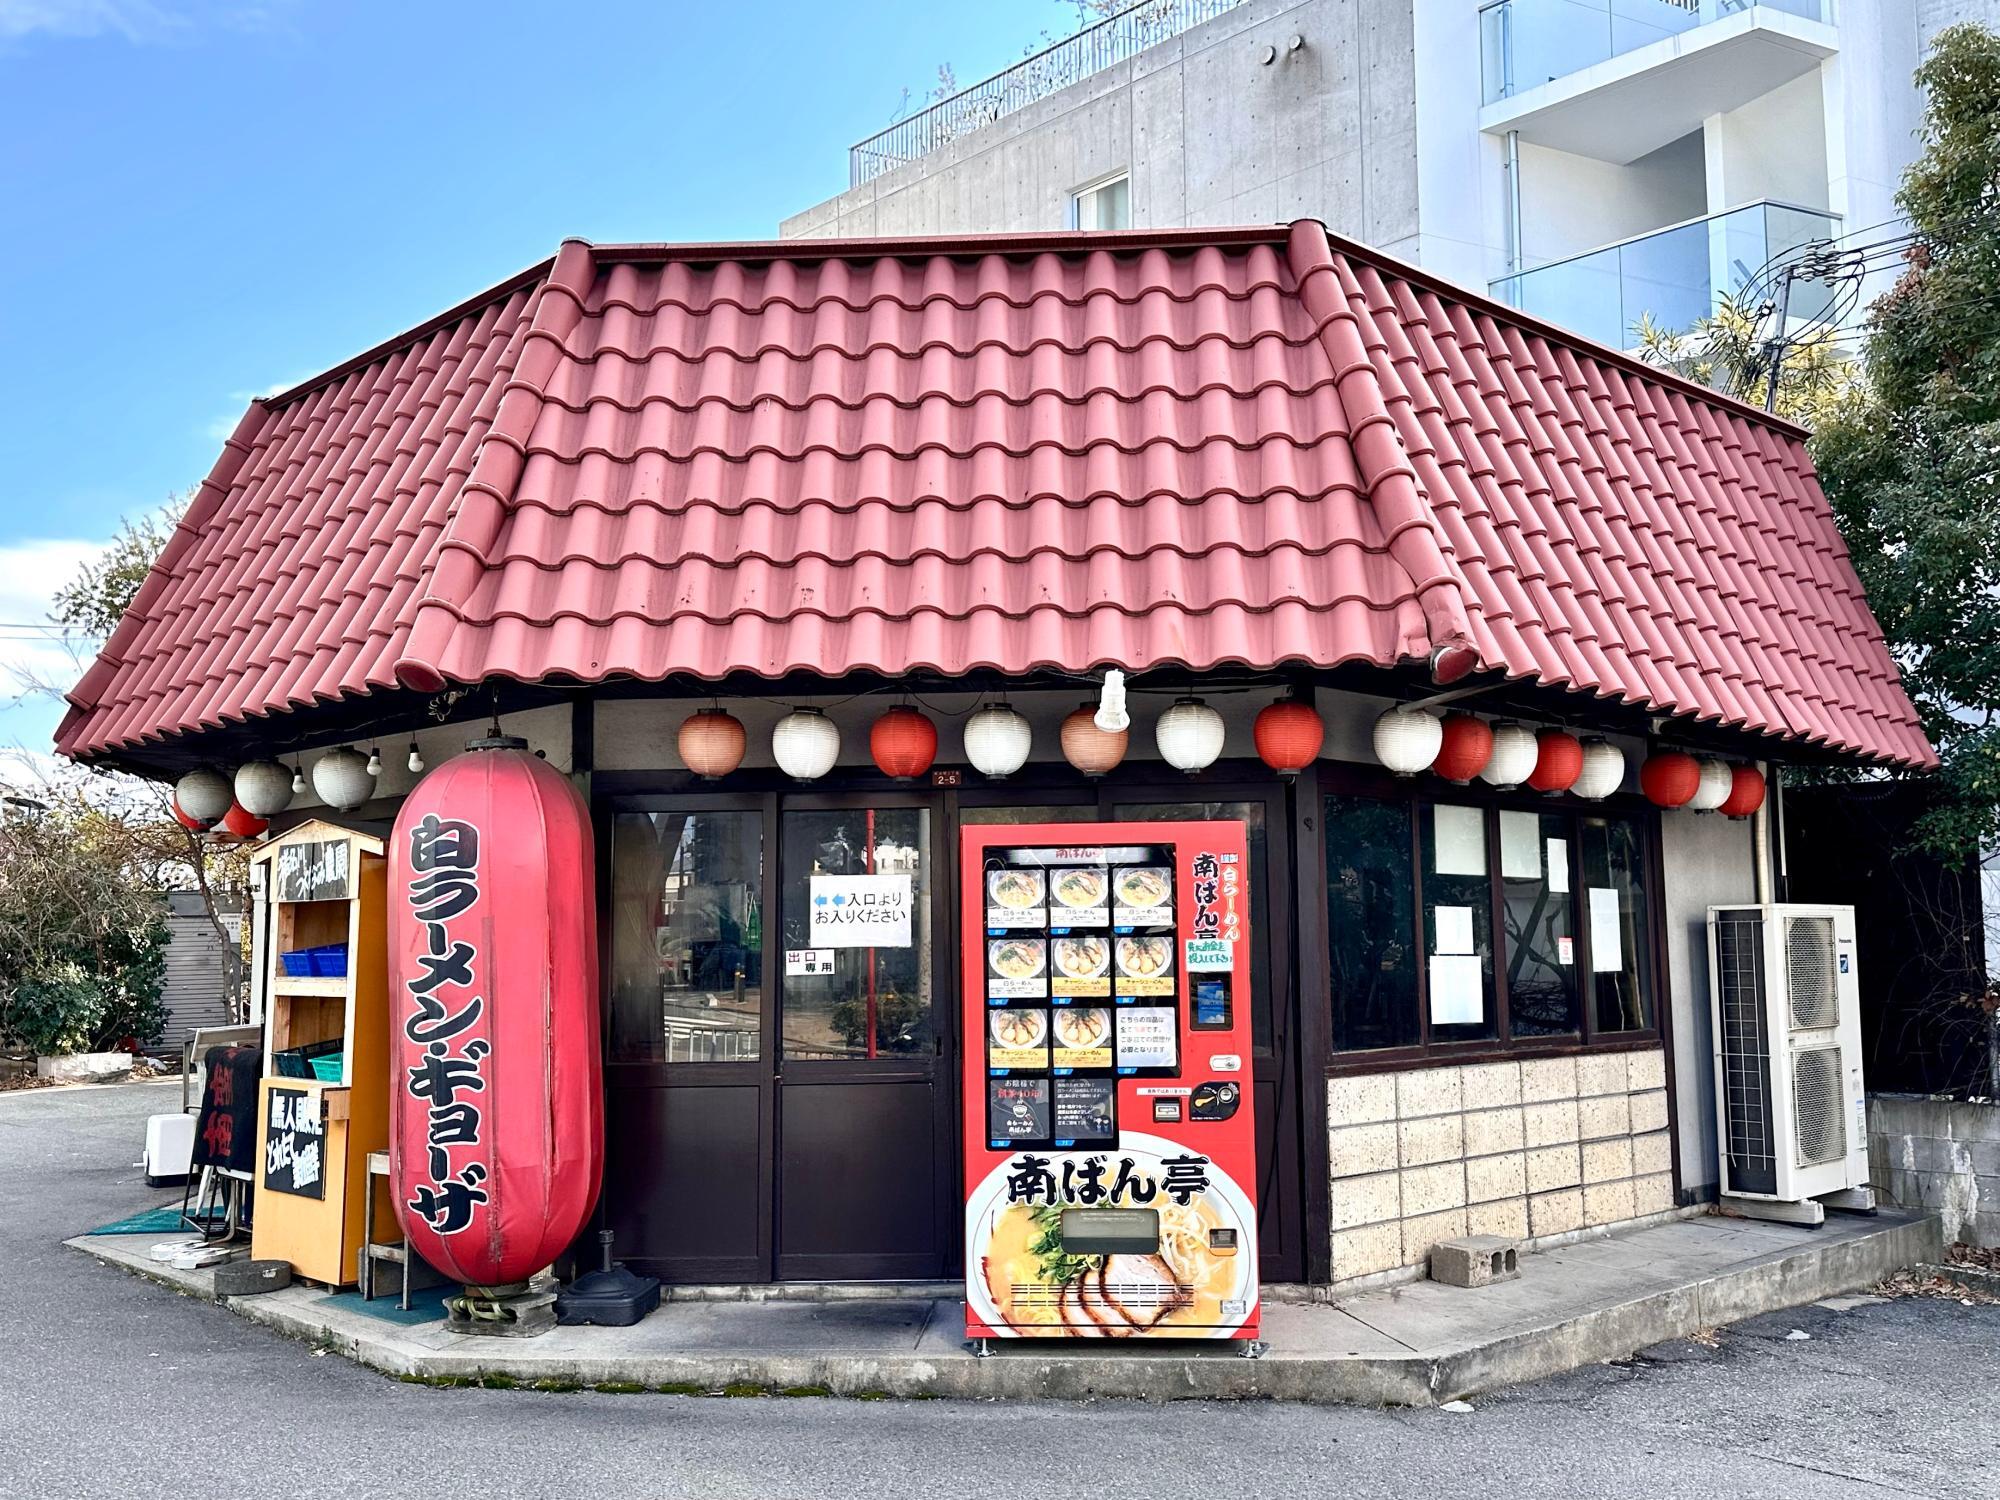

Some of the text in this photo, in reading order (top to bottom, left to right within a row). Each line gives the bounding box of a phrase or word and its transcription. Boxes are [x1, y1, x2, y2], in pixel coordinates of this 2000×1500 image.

[937, 775, 956, 785] 2-5
[847, 892, 902, 907] 入口より
[1222, 866, 1241, 941] 白らーめん
[814, 908, 907, 925] お入りください
[788, 951, 816, 963] 出口
[805, 962, 833, 973] 専用
[1007, 1153, 1211, 1206] 南ばん亭
